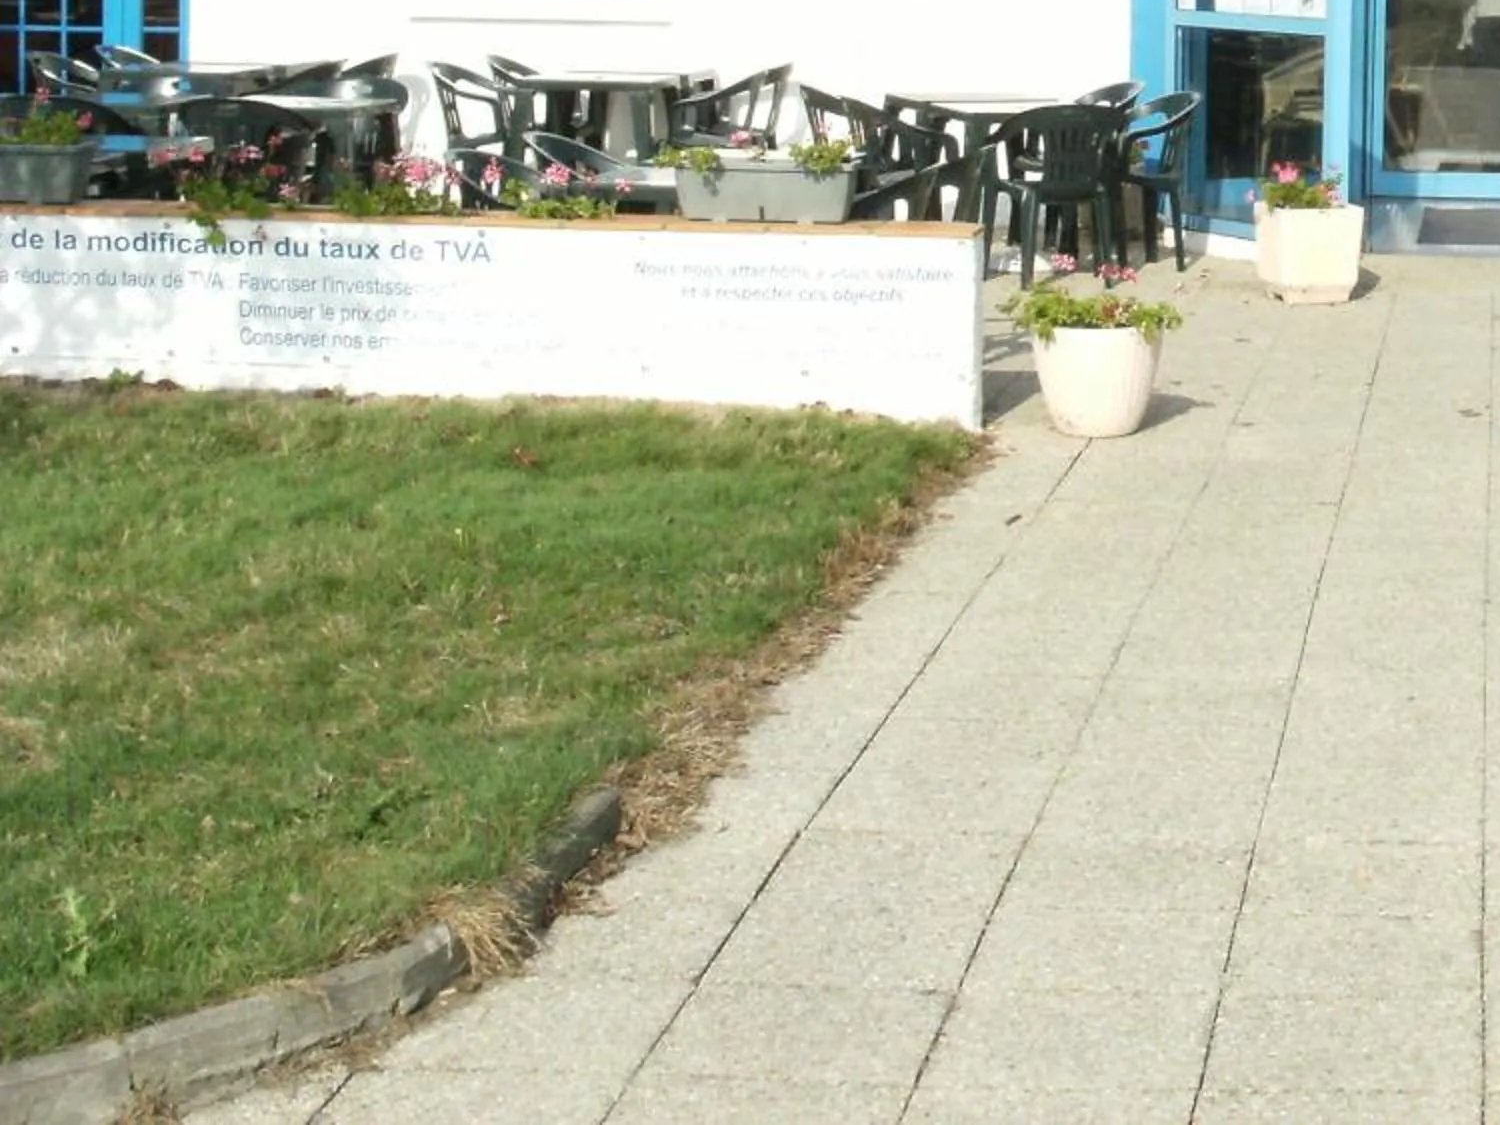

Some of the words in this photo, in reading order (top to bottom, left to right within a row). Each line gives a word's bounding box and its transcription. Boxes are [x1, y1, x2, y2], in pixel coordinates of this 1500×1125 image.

[10, 227, 45, 250] de
[54, 229, 77, 251] la
[87, 230, 265, 257] modification
[274, 236, 310, 258] du
[319, 238, 381, 261] taux
[390, 238, 425, 262] de
[434, 239, 492, 263] TVA
[96, 268, 118, 287] du
[121, 270, 157, 289] taux
[161, 271, 185, 290] de
[239, 272, 317, 294] Favoriser
[239, 299, 316, 322] Diminuer
[320, 303, 336, 322] le
[340, 303, 372, 326] prix
[239, 325, 328, 349] Conserver
[331, 331, 364, 350] nos
